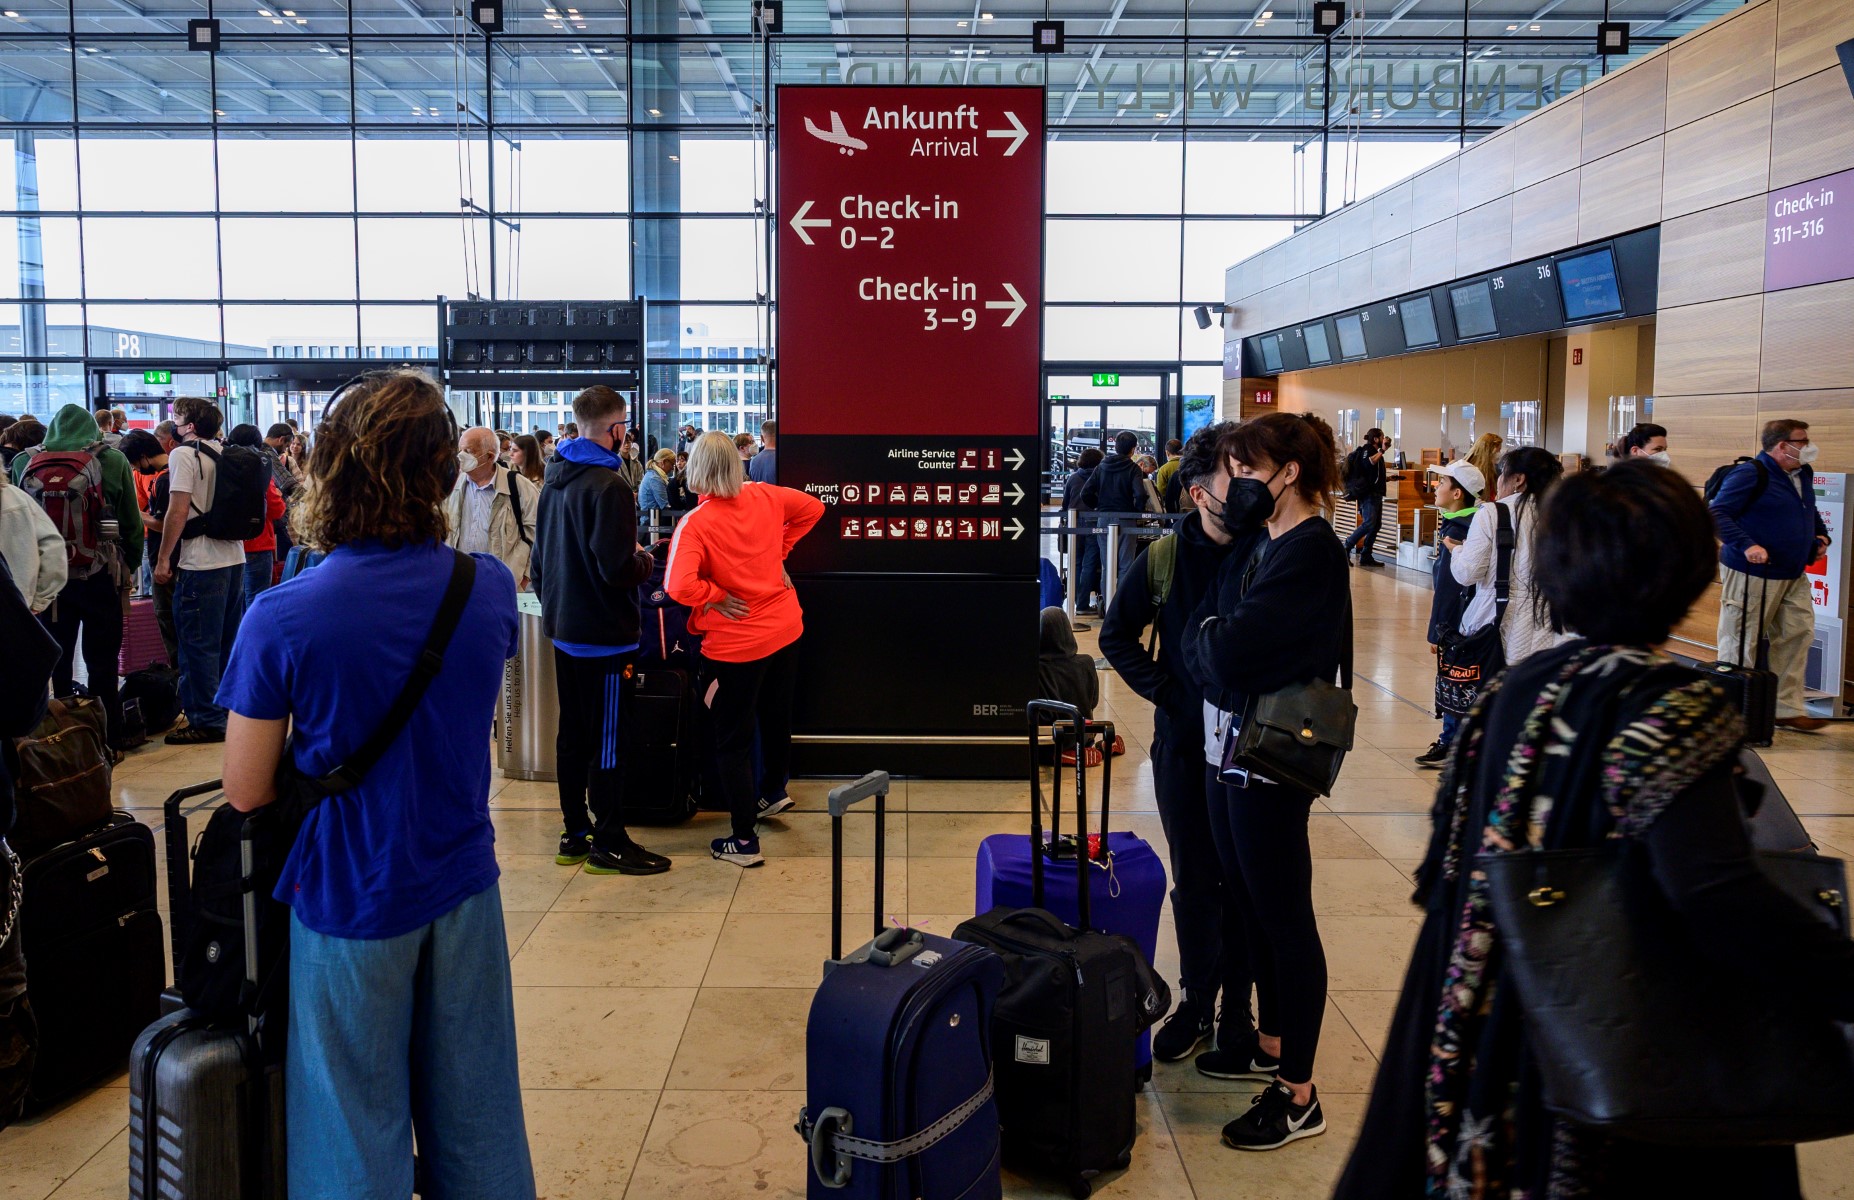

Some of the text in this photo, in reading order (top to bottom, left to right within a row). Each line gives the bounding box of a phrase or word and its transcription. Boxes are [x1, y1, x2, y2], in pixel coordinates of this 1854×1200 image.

[863, 104, 979, 130] Ankunft
[910, 137, 978, 157] Arrival
[840, 194, 959, 219] Check-in
[1774, 188, 1834, 217] Check-in
[840, 226, 895, 249] 0–2
[1773, 217, 1824, 245] 311–316
[1537, 265, 1551, 279] 316
[859, 276, 977, 301] Check-in
[1492, 277, 1505, 290] 315
[1388, 305, 1397, 316] 314
[924, 308, 977, 331] 3–9
[118, 333, 141, 358] P8
[888, 449, 956, 459] Airline Service
[918, 460, 956, 470] Counter
[1813, 477, 1826, 485] BER
[804, 483, 839, 495] Airport
[820, 494, 839, 506] City
[505, 683, 511, 693] zu
[513, 678, 520, 686] to
[514, 688, 520, 698] us
[513, 700, 522, 718] Help
[973, 704, 999, 716] BER
